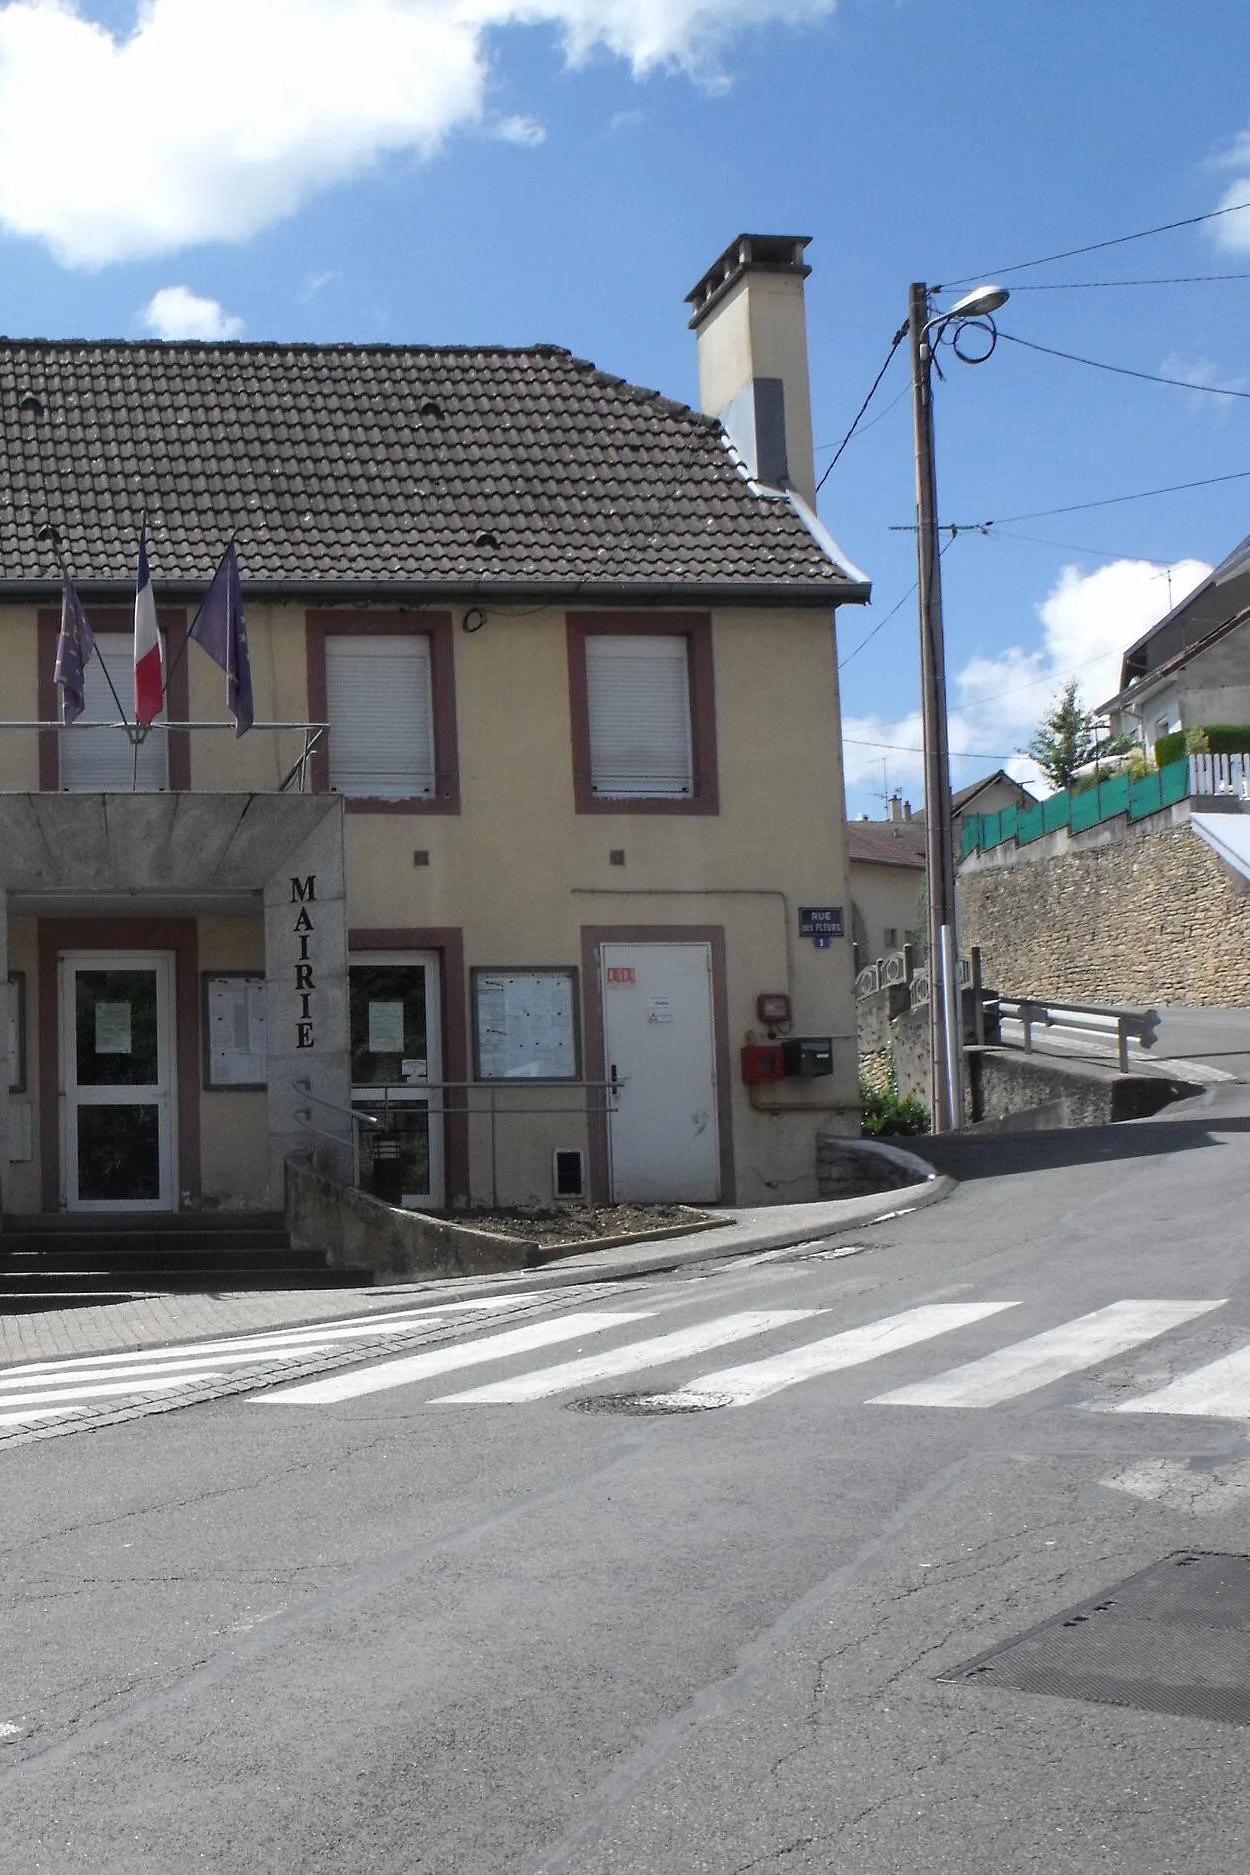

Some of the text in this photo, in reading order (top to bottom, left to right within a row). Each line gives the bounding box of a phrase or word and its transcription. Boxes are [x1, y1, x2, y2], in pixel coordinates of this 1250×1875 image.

[811, 911, 831, 921] RUE
[815, 923, 841, 932] FLEURS
[819, 938, 824, 947] 1
[290, 875, 317, 1049] MAIRIE
